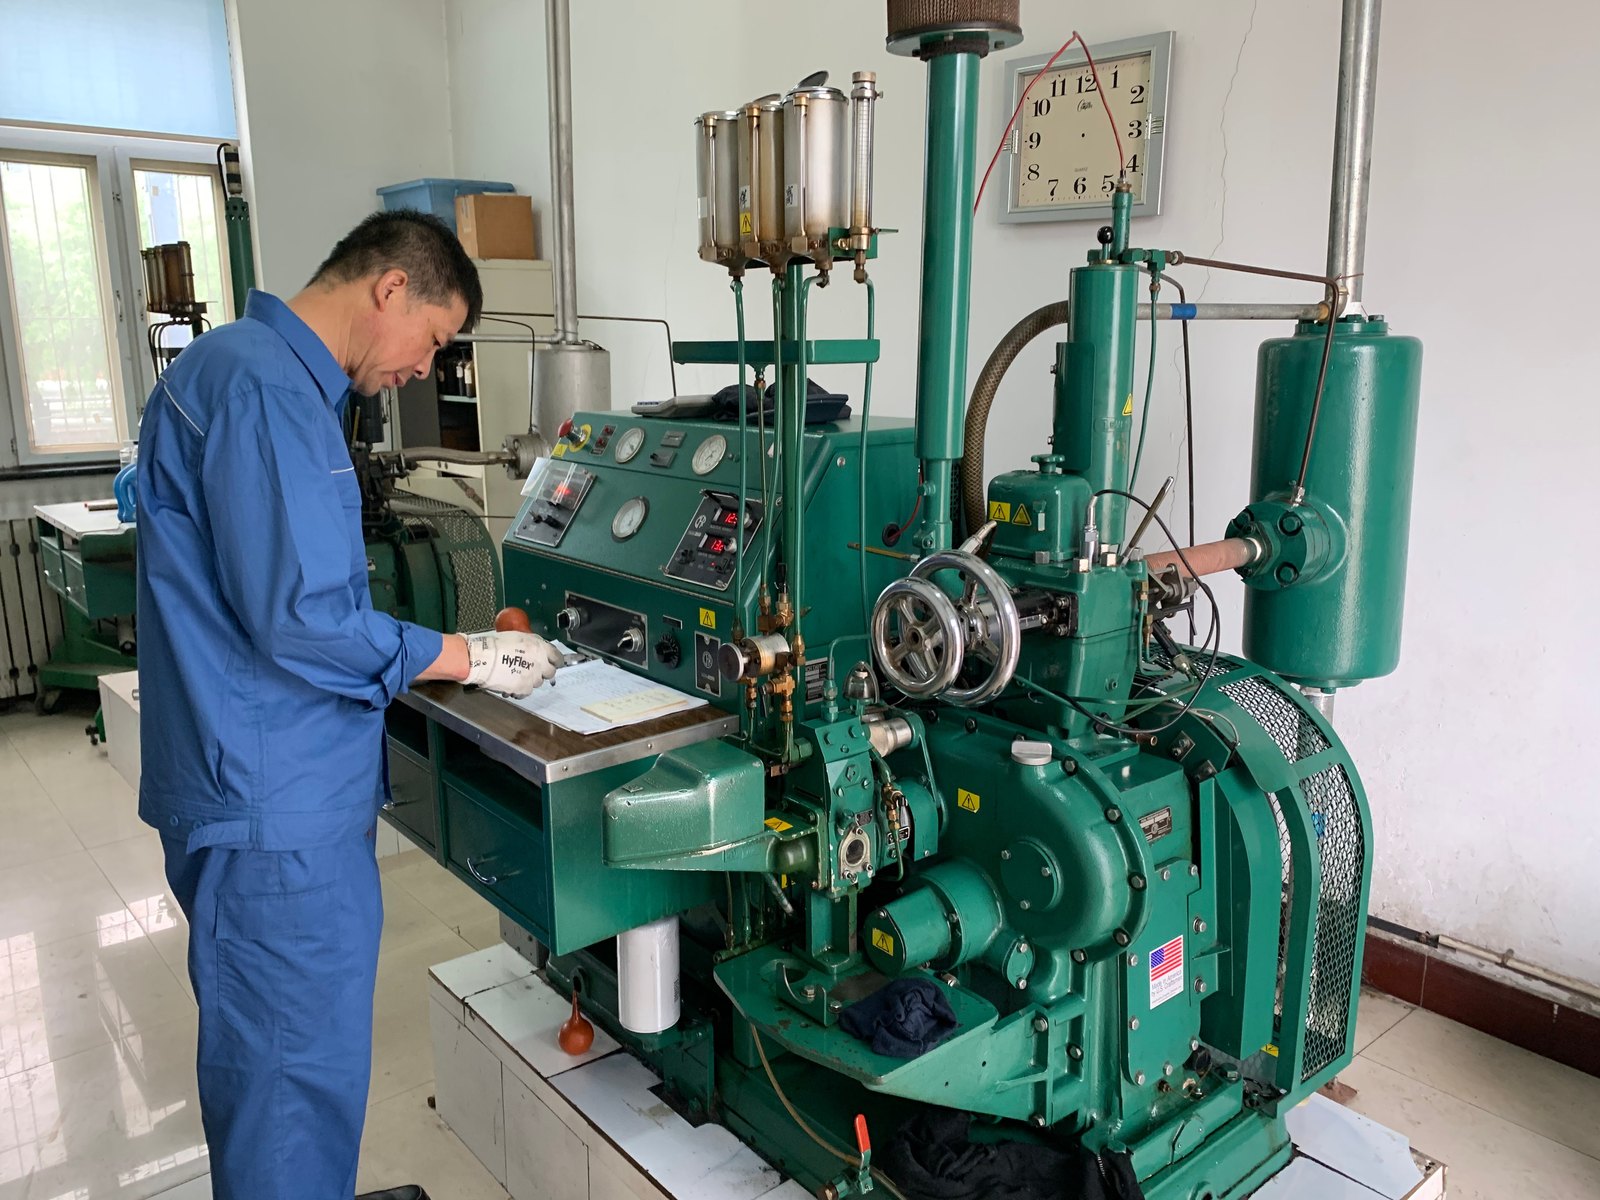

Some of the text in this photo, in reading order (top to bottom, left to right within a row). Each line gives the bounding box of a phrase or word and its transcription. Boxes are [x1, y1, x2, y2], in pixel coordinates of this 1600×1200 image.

[1049, 77, 1068, 98] 11
[1075, 73, 1098, 94] 12
[1111, 69, 1120, 89] 1
[1129, 84, 1145, 105] 2
[1031, 98, 1051, 118] 10
[1127, 119, 1143, 139] 3
[1028, 131, 1041, 150] 9
[1026, 163, 1040, 182] 8
[1125, 154, 1140, 173] 4
[1047, 178, 1059, 197] 7
[1073, 176, 1087, 195] 6
[1101, 173, 1115, 193] 5
